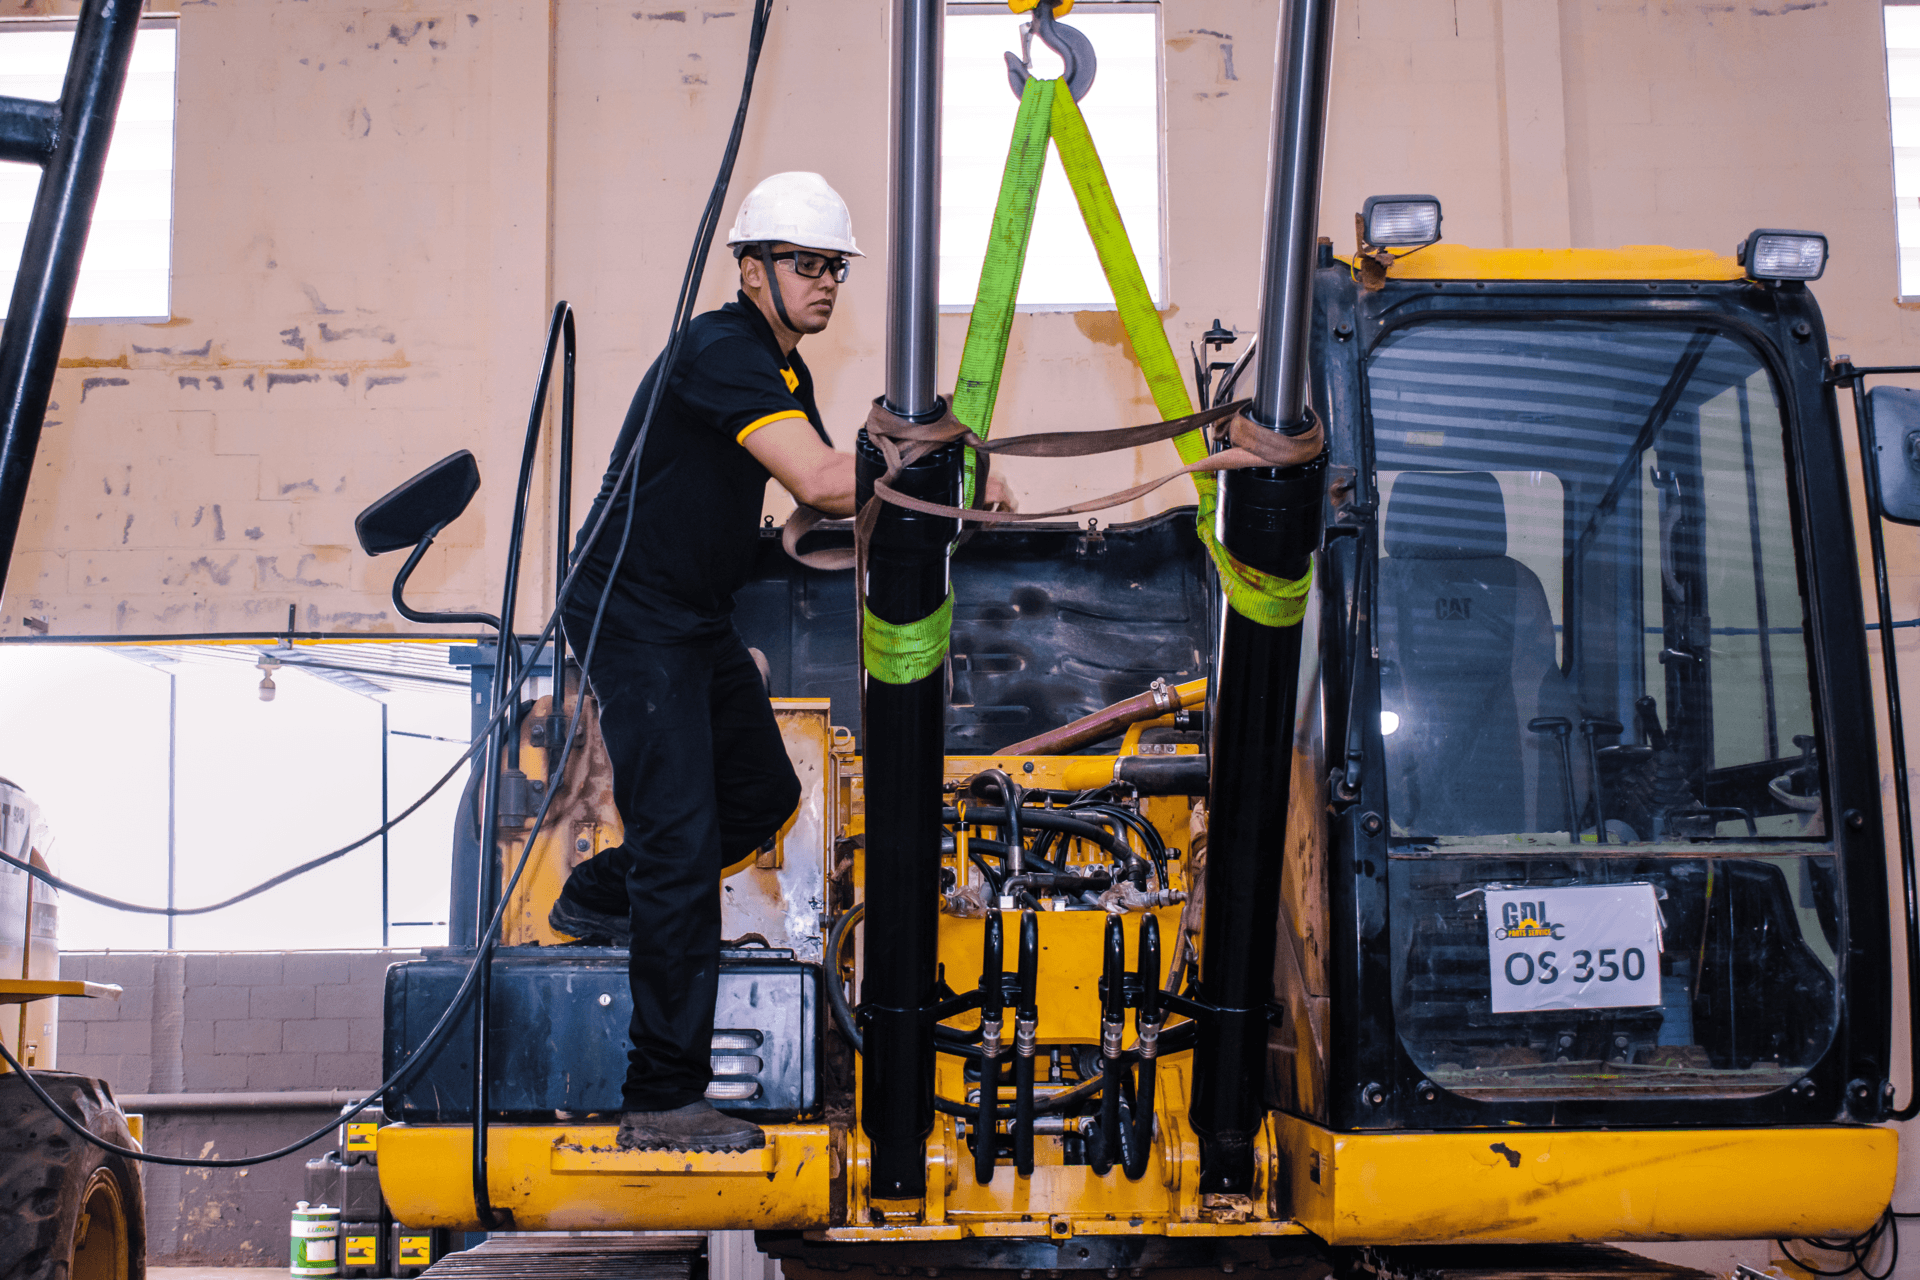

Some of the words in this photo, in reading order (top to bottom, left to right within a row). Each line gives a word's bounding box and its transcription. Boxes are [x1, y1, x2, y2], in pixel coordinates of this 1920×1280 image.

[1435, 597, 1472, 620] CAT
[1501, 900, 1551, 930] GDL
[1508, 929, 1527, 937] PARTS
[1504, 951, 1559, 986] OS
[1572, 947, 1646, 983] 350
